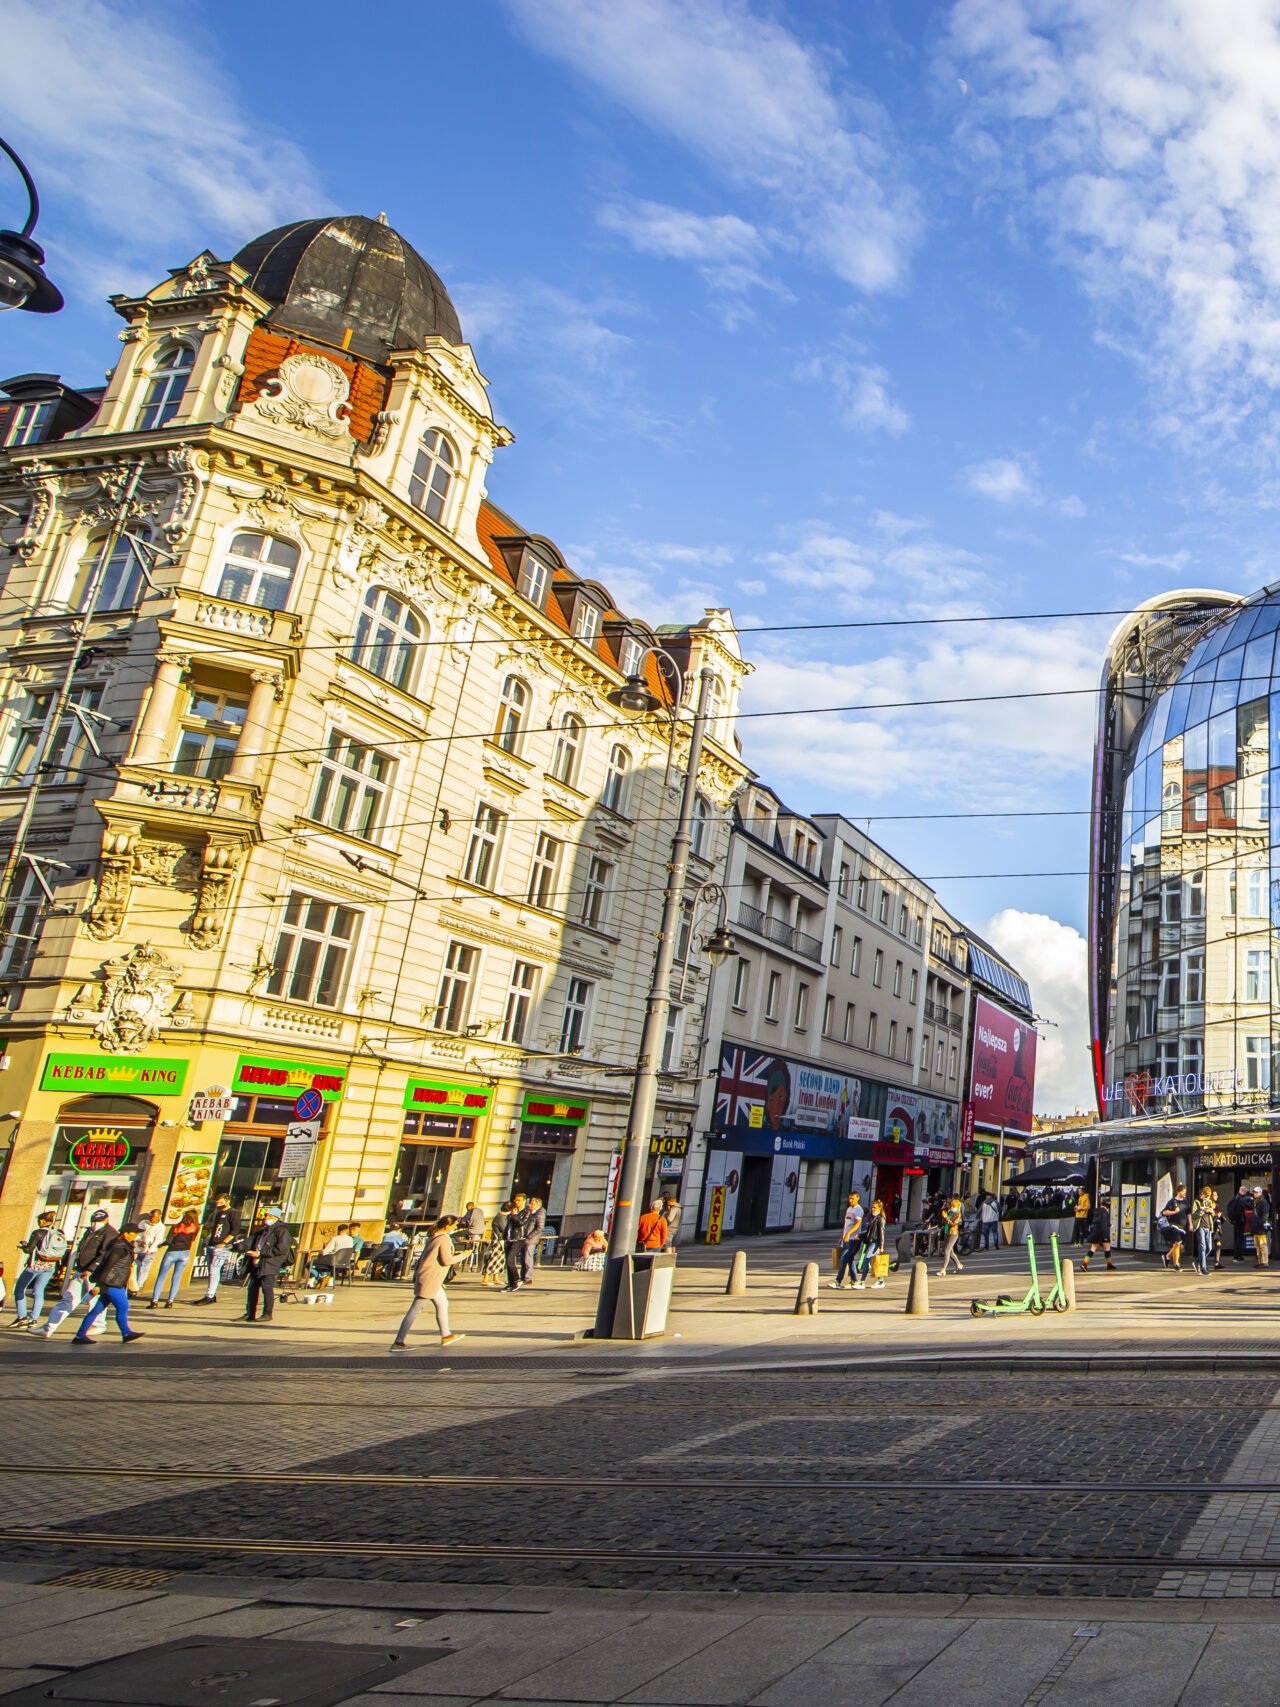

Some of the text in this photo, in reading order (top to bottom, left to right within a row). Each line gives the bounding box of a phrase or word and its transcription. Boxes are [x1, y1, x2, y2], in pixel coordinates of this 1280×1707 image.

[979, 1025, 1007, 1053] Najlepsza
[51, 1065, 177, 1083] KEBAB KING
[239, 1065, 344, 1092] KEBAB KING
[800, 1071, 840, 1093] SECOND HAND
[798, 1089, 837, 1110] from London
[975, 1082, 994, 1100] ever?
[1101, 1081, 1124, 1102] WE
[194, 1098, 231, 1109] KEBAB
[196, 1109, 222, 1120] KING
[967, 1109, 975, 1142] APTEKA
[74, 1142, 127, 1157] KEBAB
[782, 1139, 806, 1150] Bank Polski
[78, 1157, 116, 1169] KING
[1216, 1153, 1273, 1167] KATOWICKA
[709, 1186, 722, 1242] KANTOR
